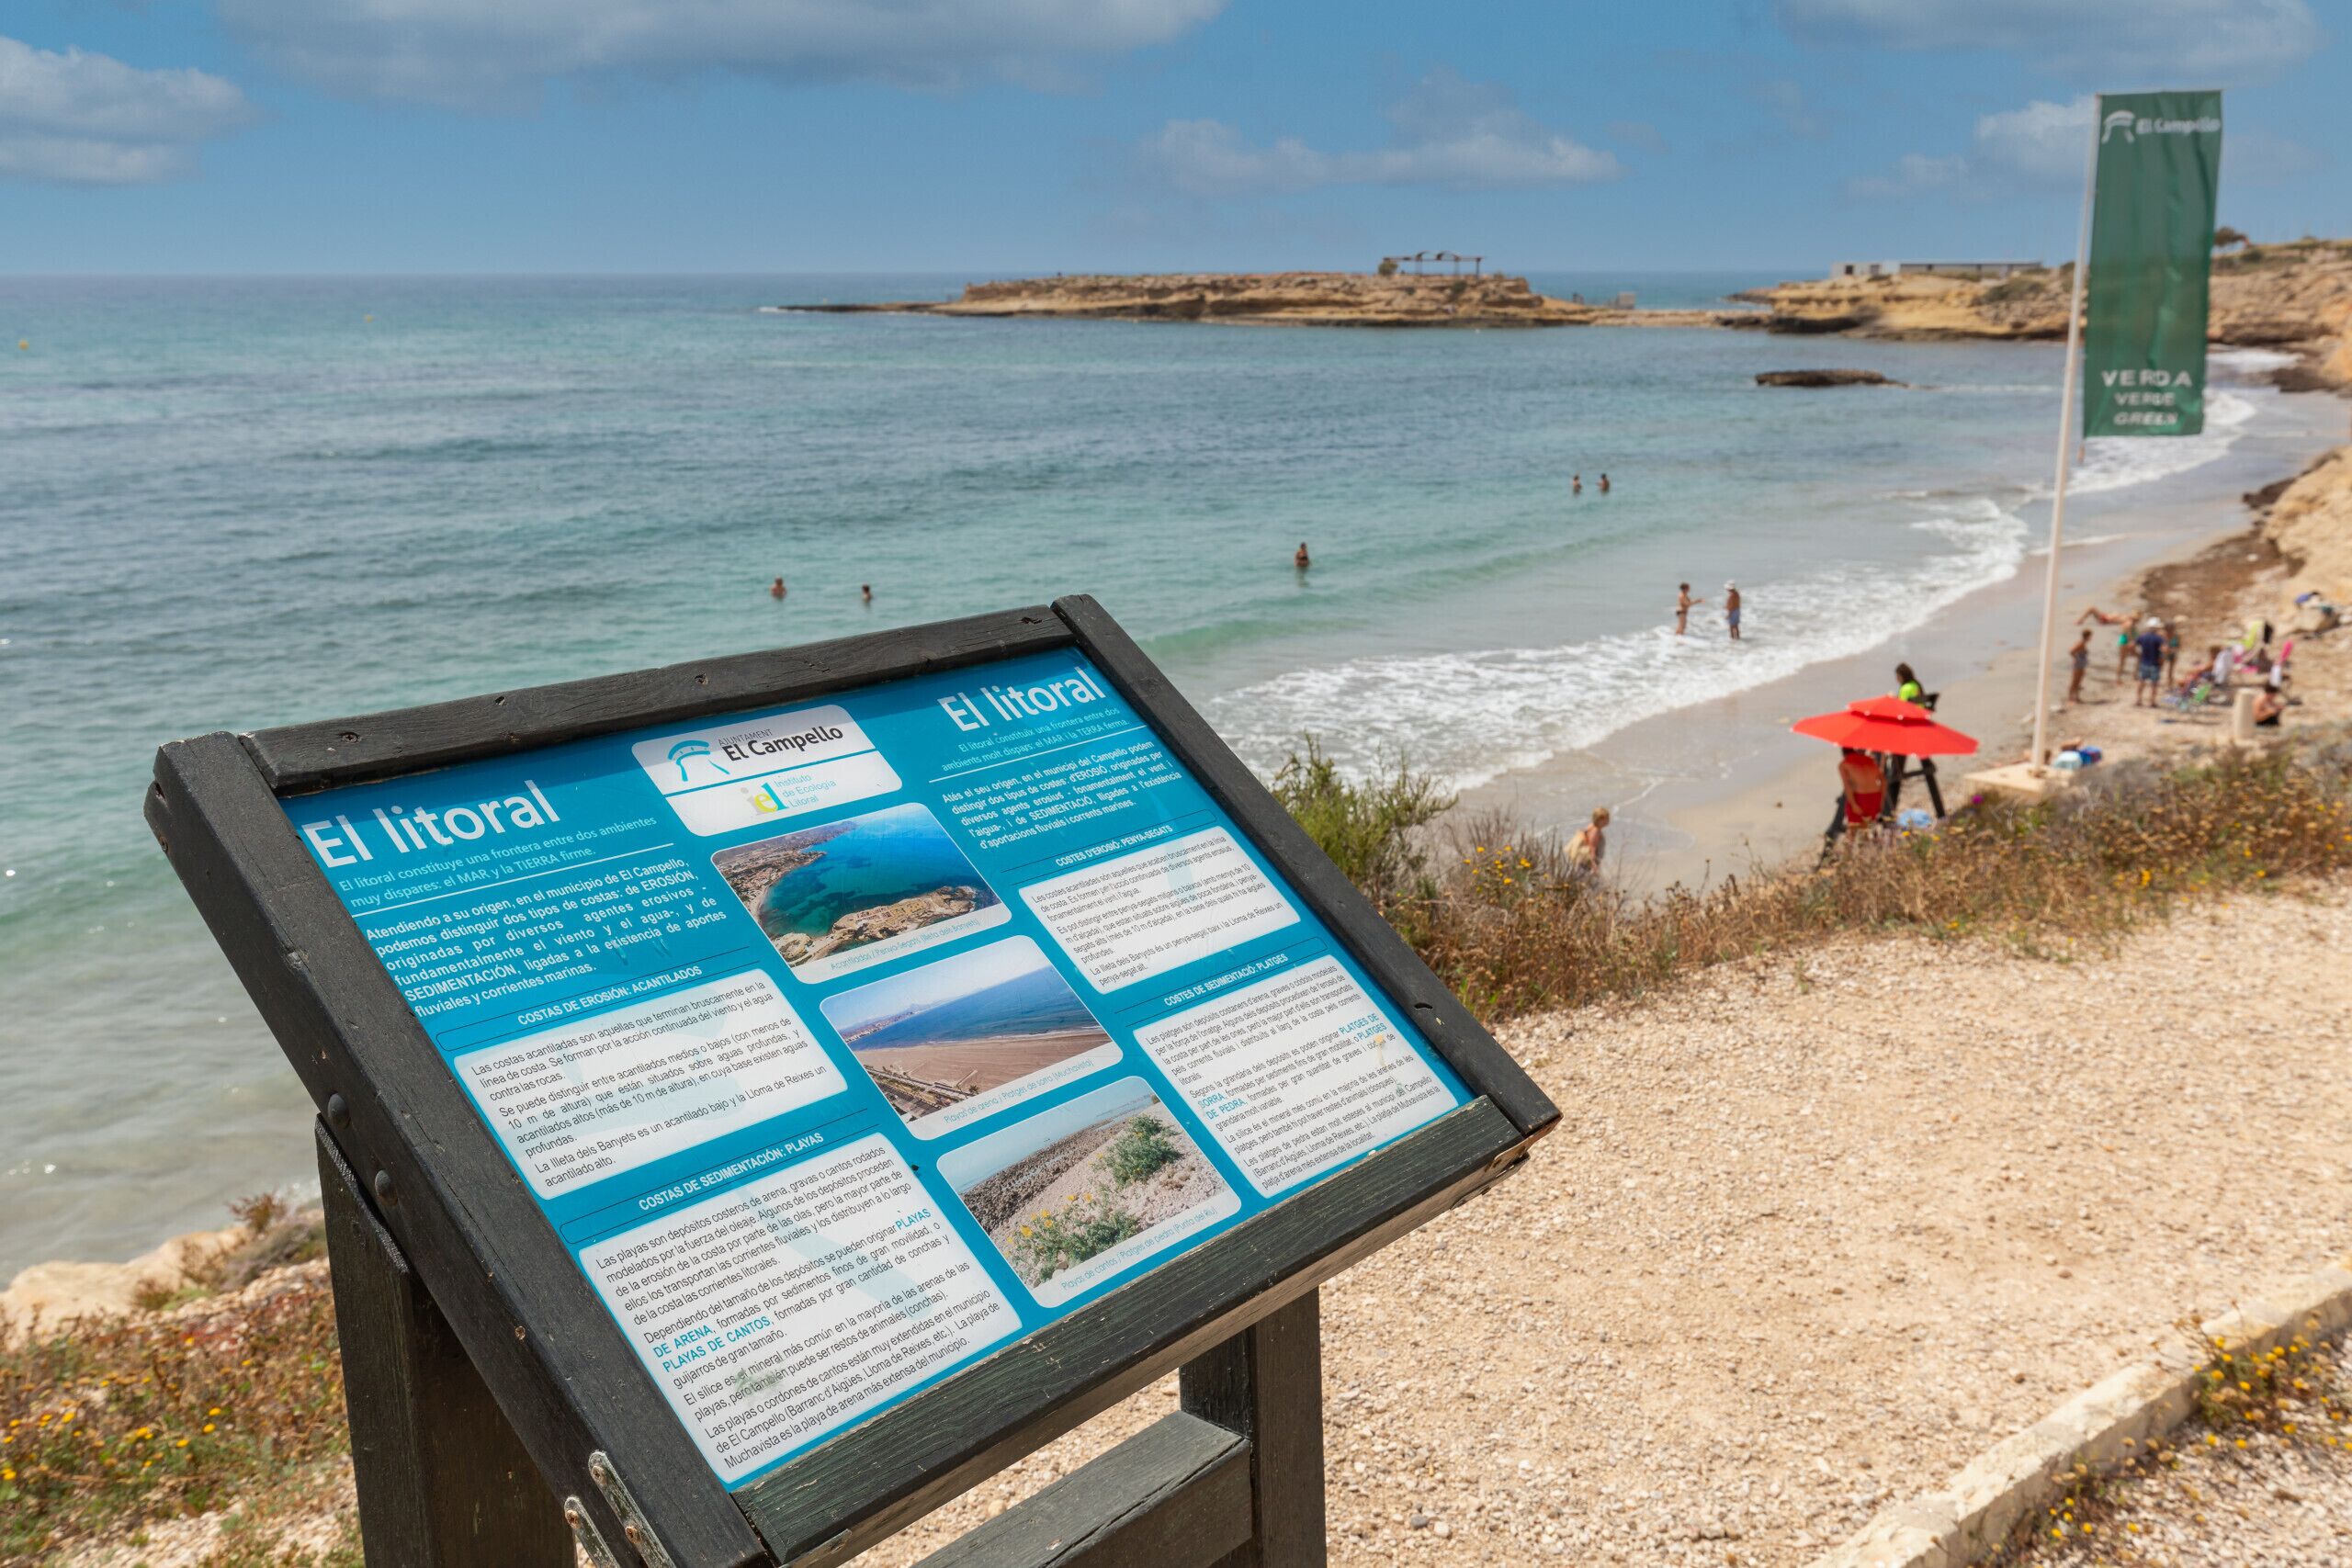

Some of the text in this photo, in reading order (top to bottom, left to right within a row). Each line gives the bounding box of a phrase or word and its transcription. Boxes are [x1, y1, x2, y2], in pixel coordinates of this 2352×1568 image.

[2101, 369, 2193, 387] VERDA
[2114, 391, 2176, 406] VERDE
[939, 667, 1105, 731] El litoral
[718, 728, 772, 746] AJUNTAMENT
[721, 726, 842, 761] El Campello
[942, 757, 982, 771] ambients
[982, 750, 1002, 761] molt
[1003, 743, 1035, 755] dispars:
[1043, 735, 1065, 745] MAR
[1076, 725, 1104, 736] TERRA
[1102, 720, 1129, 729] ferma.
[958, 744, 968, 752] El
[967, 738, 994, 750] litoral
[1050, 717, 1083, 728] frontera
[1083, 713, 1104, 721] entre
[775, 775, 812, 787] Instituto
[796, 781, 836, 794] Ecología
[952, 799, 987, 814] distingir
[988, 795, 1005, 805] dos
[1004, 790, 1027, 800] tipus
[1027, 785, 1039, 794] de
[1039, 778, 1069, 791] costes:
[1110, 756, 1149, 771] originades
[1149, 751, 1162, 761] per
[964, 788, 974, 797] el
[974, 785, 991, 795] seu
[991, 778, 1022, 790] origen,
[1034, 770, 1043, 779] el
[1043, 761, 1078, 776] municipi
[1078, 757, 1091, 766] del
[1091, 749, 1127, 762] Campello
[1128, 741, 1154, 754] podem
[303, 781, 560, 867] El litoral
[788, 795, 819, 807] Litoral
[339, 818, 657, 891] El litoral constituye una frontera entre dos ambientes
[1056, 852, 1086, 866] COSTES
[1121, 825, 1172, 846] PENYA-SEGATS
[351, 849, 595, 907] muy dispares: el MAR y la TIERRA firme.
[367, 859, 689, 940] Atendiendo a su origen, en el municipio de El Campello,
[376, 871, 698, 958] podemos distinguir dos tipos de costas: de EROSIÓN,
[386, 946, 463, 970] originadas
[472, 937, 495, 952] por
[505, 921, 563, 941] diversos
[583, 904, 633, 921] agentes
[641, 888, 694, 907] erosivos
[415, 964, 596, 1017] fluviales y corrientes marinas.
[518, 966, 702, 1024] COSTAS DE EROSIÓN: ACANTILADOS
[1164, 954, 1288, 1006] COSTES DE SEDIMENTACIÓ: PLATGES
[471, 1065, 492, 1076] Las
[493, 1055, 525, 1069] costas
[526, 1039, 578, 1059] acantiladas
[579, 1033, 597, 1043] son
[597, 1021, 635, 1037] aquellas
[636, 1017, 652, 1027] que
[652, 1005, 691, 1021] terminan
[690, 989, 744, 1010] bruscamente
[1339, 1018, 1369, 1034] PLATGES
[545, 1157, 616, 1187] acantilado alto.
[639, 1133, 823, 1210] COSTAS DE SEDIMENTACIÓN: PLAYAS
[662, 1235, 949, 1372] PLAYAS DE CANTOS, formadas por gran cantidad de conchas y
